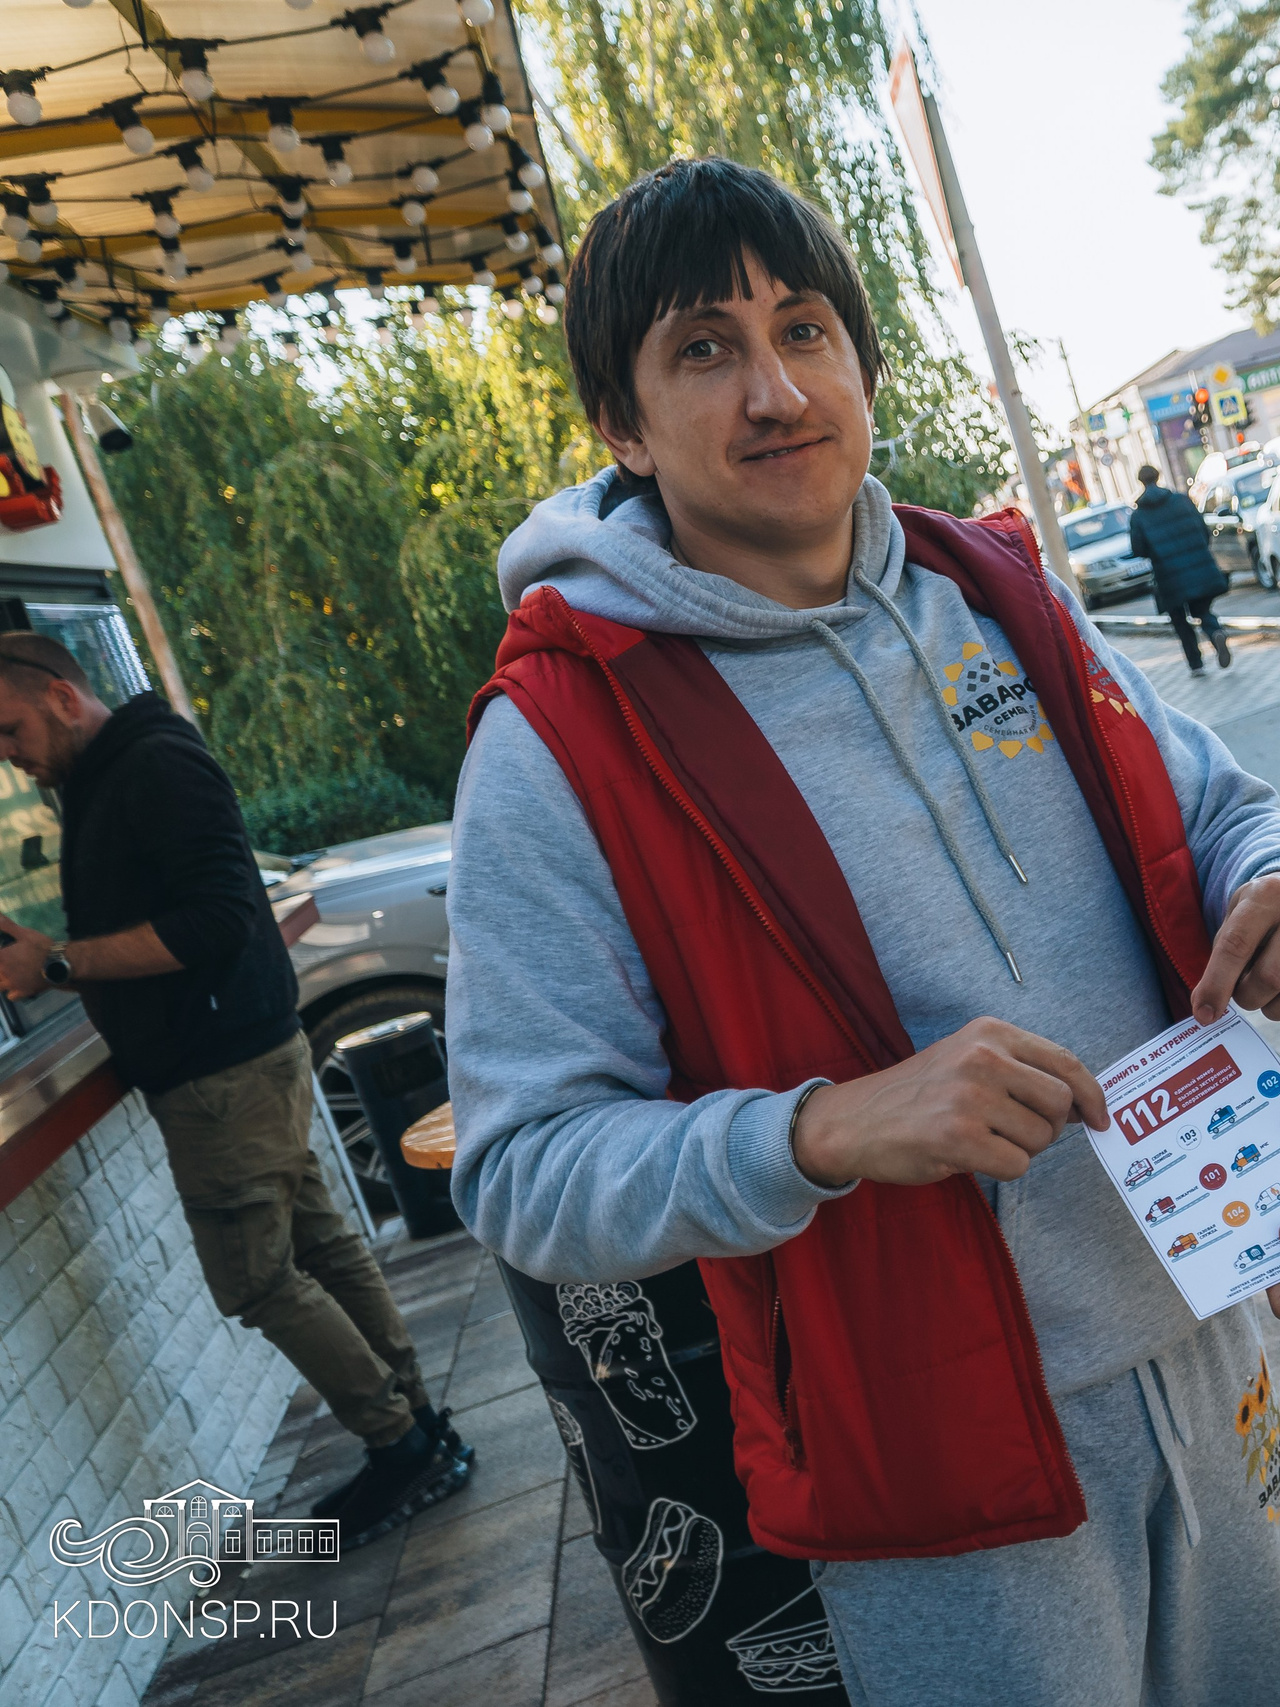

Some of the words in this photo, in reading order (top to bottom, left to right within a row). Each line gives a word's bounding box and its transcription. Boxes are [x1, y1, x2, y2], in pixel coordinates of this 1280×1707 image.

[1101, 1062, 1140, 1092] ЗВОНИТЬ
[1139, 1057, 1148, 1066] В
[1147, 1024, 1201, 1061] ЭКСТРЕННОМ
[1173, 1077, 1196, 1096] единый
[1195, 1066, 1215, 1081] номер
[1176, 1084, 1199, 1102] вызова
[1198, 1063, 1232, 1089] экстренных
[1180, 1081, 1219, 1109] оперативных
[1218, 1068, 1237, 1085] служб
[1261, 1075, 1278, 1090] 102
[1119, 1088, 1180, 1137] 112
[1179, 1128, 1196, 1143] 103
[1203, 1168, 1221, 1183] 101
[1225, 1204, 1245, 1220] 104
